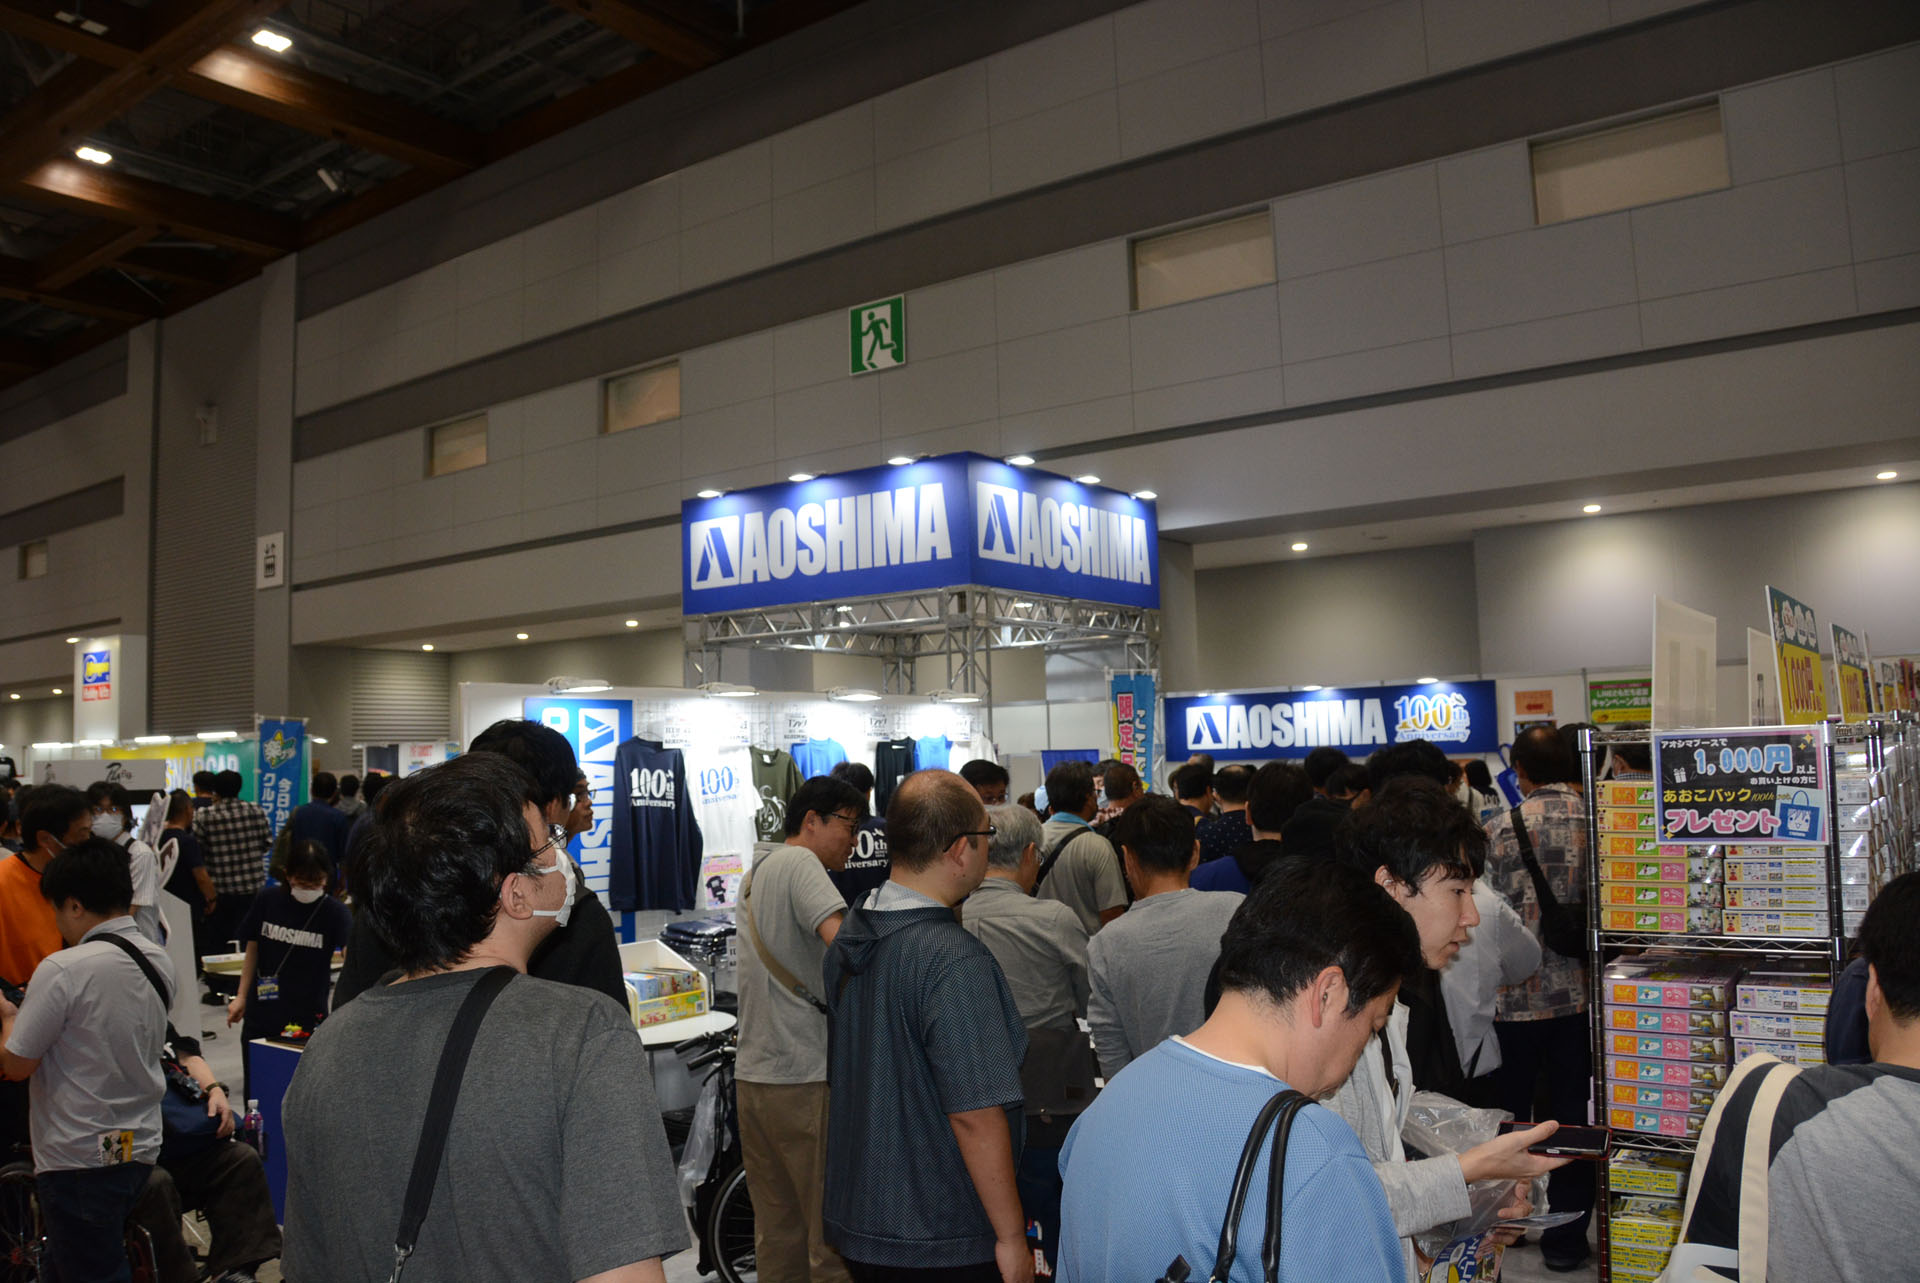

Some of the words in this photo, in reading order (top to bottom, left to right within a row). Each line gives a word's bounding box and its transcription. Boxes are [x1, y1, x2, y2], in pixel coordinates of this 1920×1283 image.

[740, 483, 952, 584] AOSHIMA
[1021, 492, 1151, 585] AOSHIMA
[1228, 698, 1387, 749] AOSHIMA
[1694, 744, 1793, 776] 1,000円
[1796, 765, 1816, 774] 以上
[1750, 776, 1817, 785] お買い上げの方に
[1665, 808, 1782, 834] プレゼント
